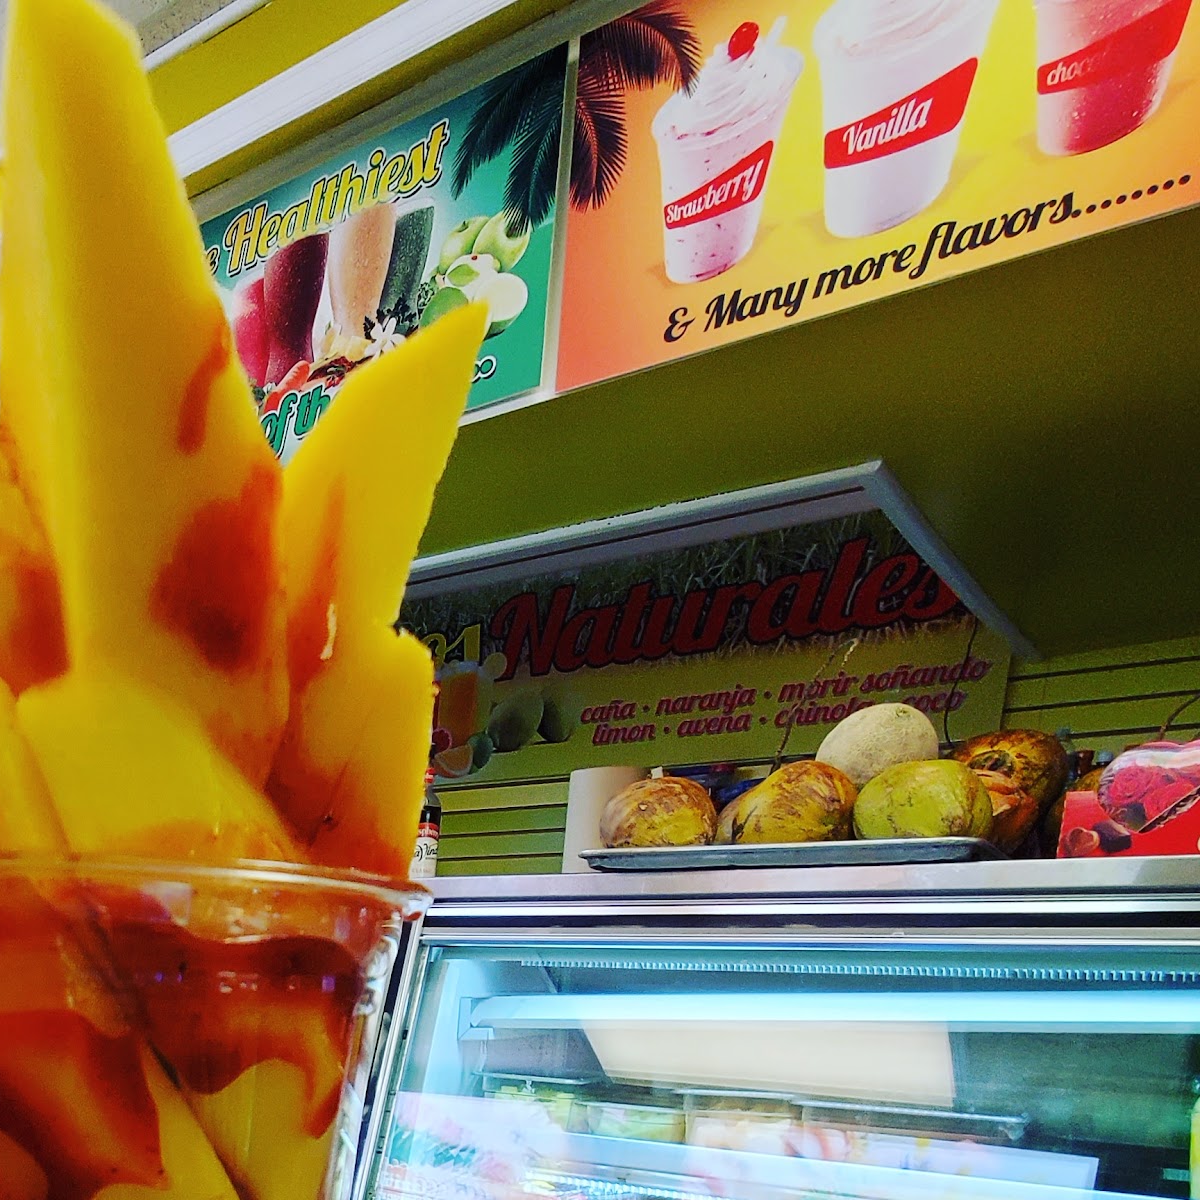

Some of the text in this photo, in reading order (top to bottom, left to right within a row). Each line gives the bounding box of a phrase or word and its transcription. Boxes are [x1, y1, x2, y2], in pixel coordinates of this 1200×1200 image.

[842, 97, 933, 157] Vanilla
[224, 118, 449, 277] Healthiest
[666, 156, 761, 224] Strawberry
[663, 306, 695, 344] &
[704, 275, 809, 332] Many
[811, 242, 917, 301] more
[294, 384, 331, 436] th
[491, 537, 961, 682] Naturales
[580, 656, 993, 724] caña naranja morir soñando
[591, 721, 656, 747] limon
[676, 710, 752, 736] avena
